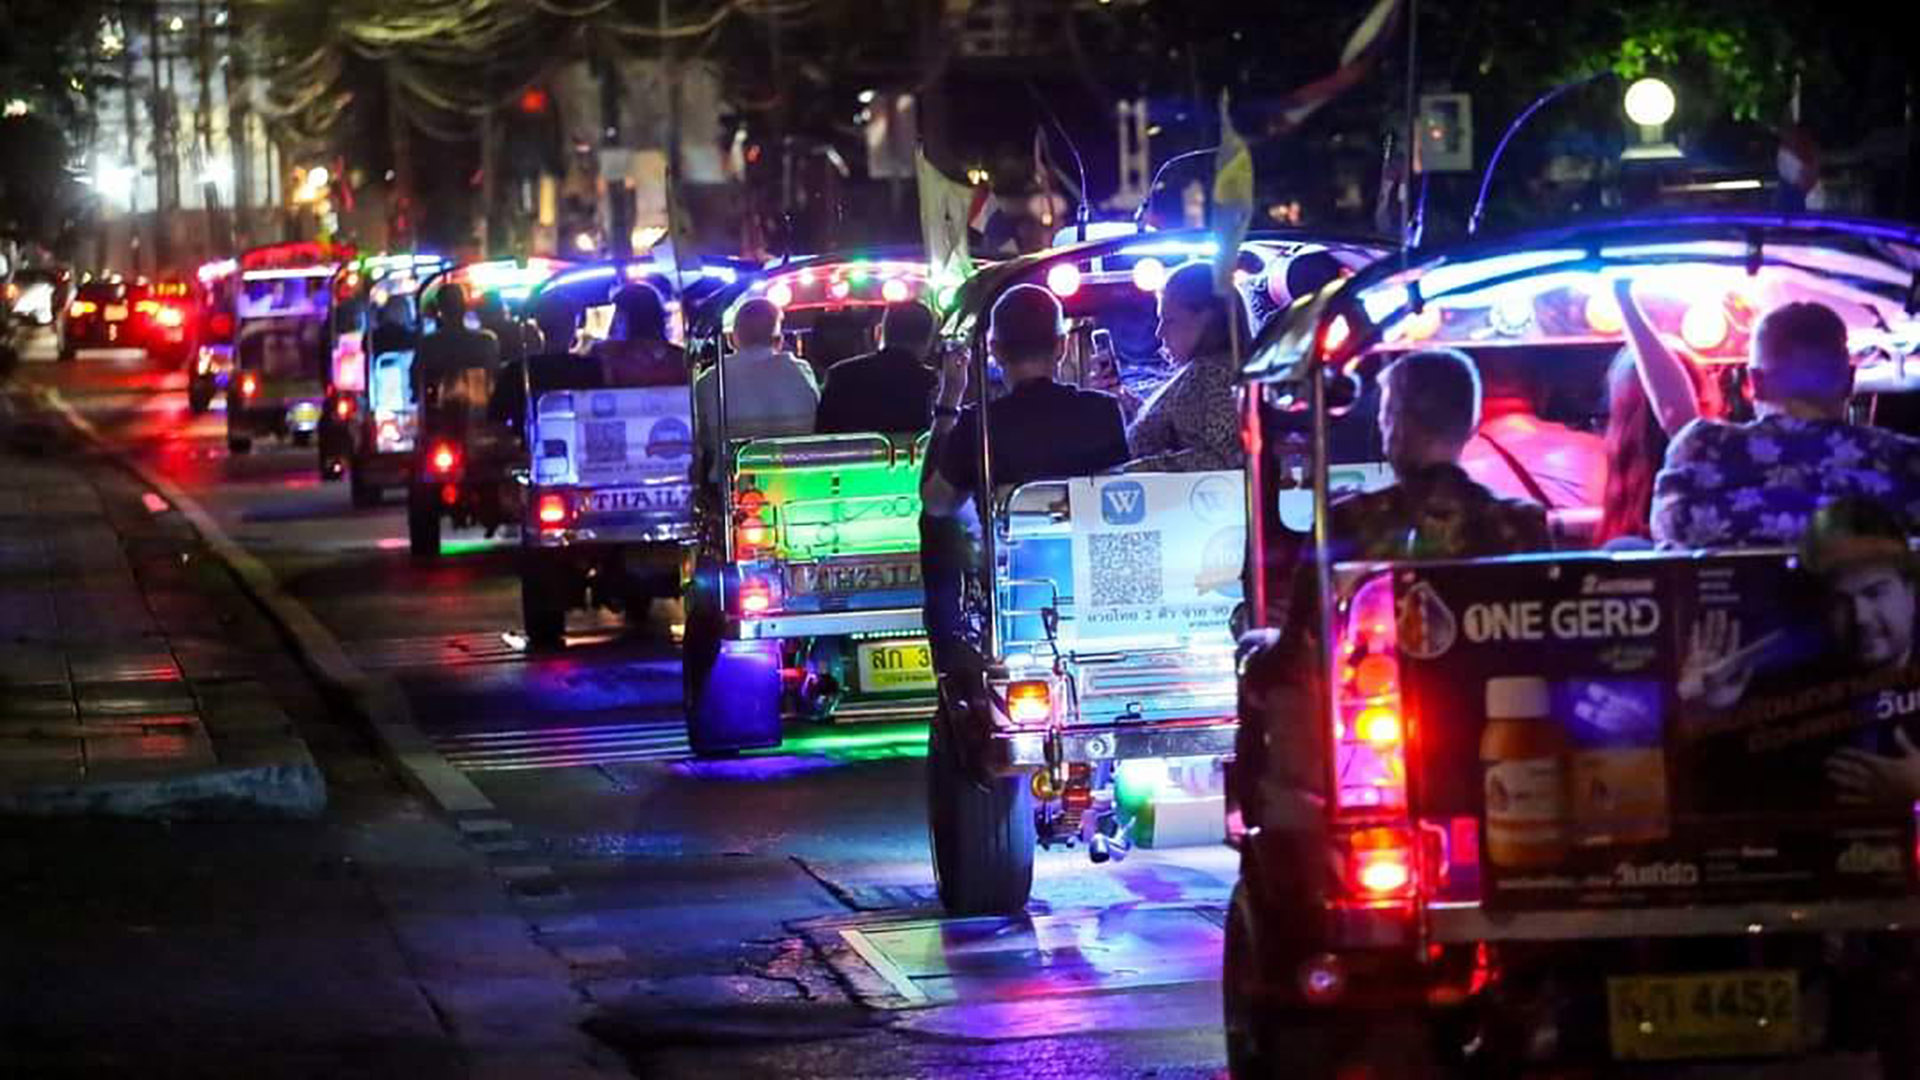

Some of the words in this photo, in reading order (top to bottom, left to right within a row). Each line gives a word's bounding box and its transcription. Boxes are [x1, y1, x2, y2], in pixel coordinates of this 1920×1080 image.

[1463, 601, 1545, 642] ONE
[1550, 597, 1661, 640] GERD
[1692, 979, 1793, 1021] 4452
